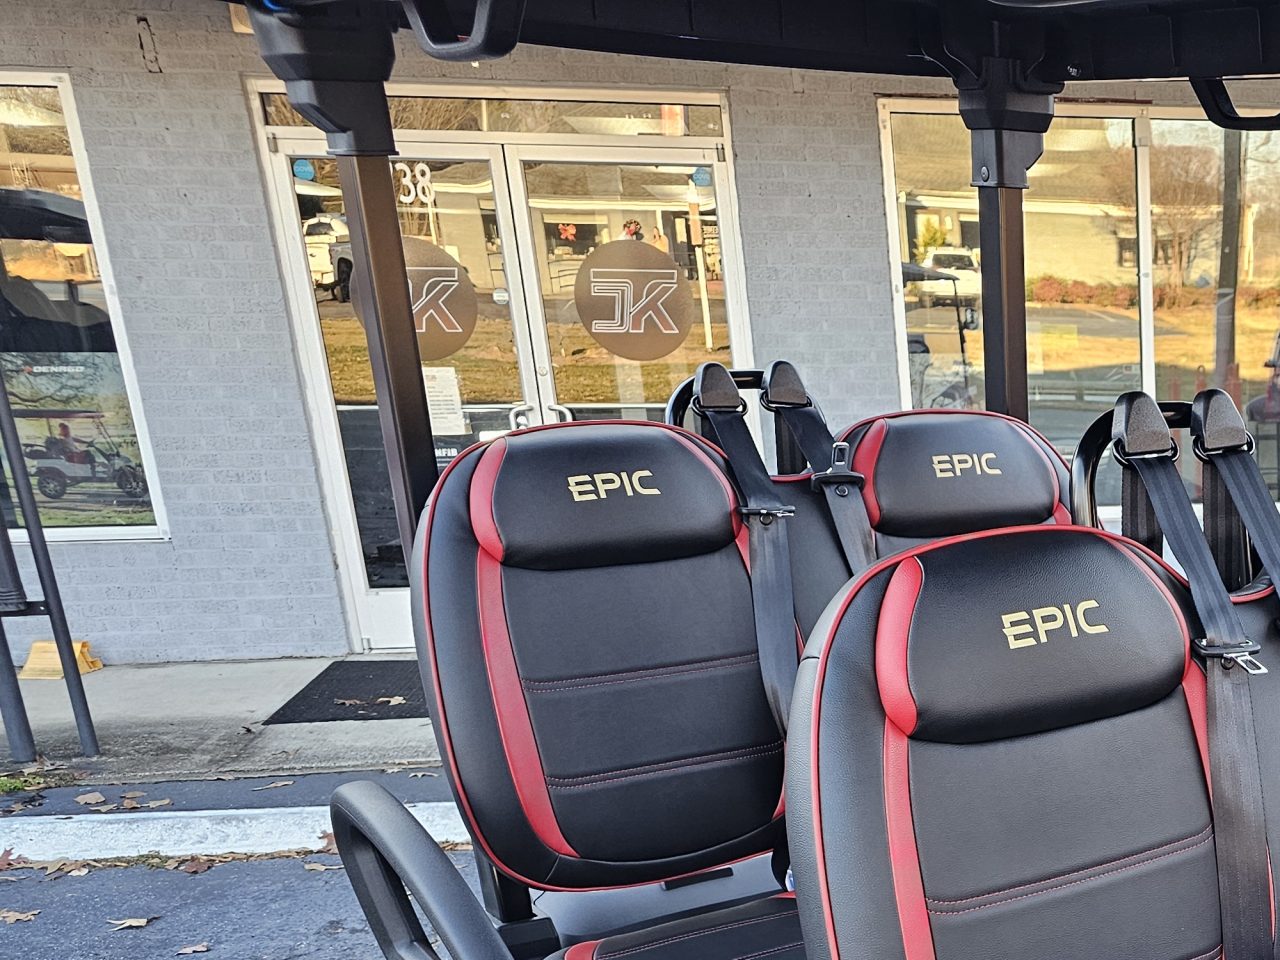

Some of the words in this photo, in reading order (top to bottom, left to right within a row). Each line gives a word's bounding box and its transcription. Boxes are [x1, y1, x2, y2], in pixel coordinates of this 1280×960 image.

[932, 453, 1002, 478] EPIC
[567, 470, 661, 501] EPIC
[1001, 600, 1110, 649] EPIC
